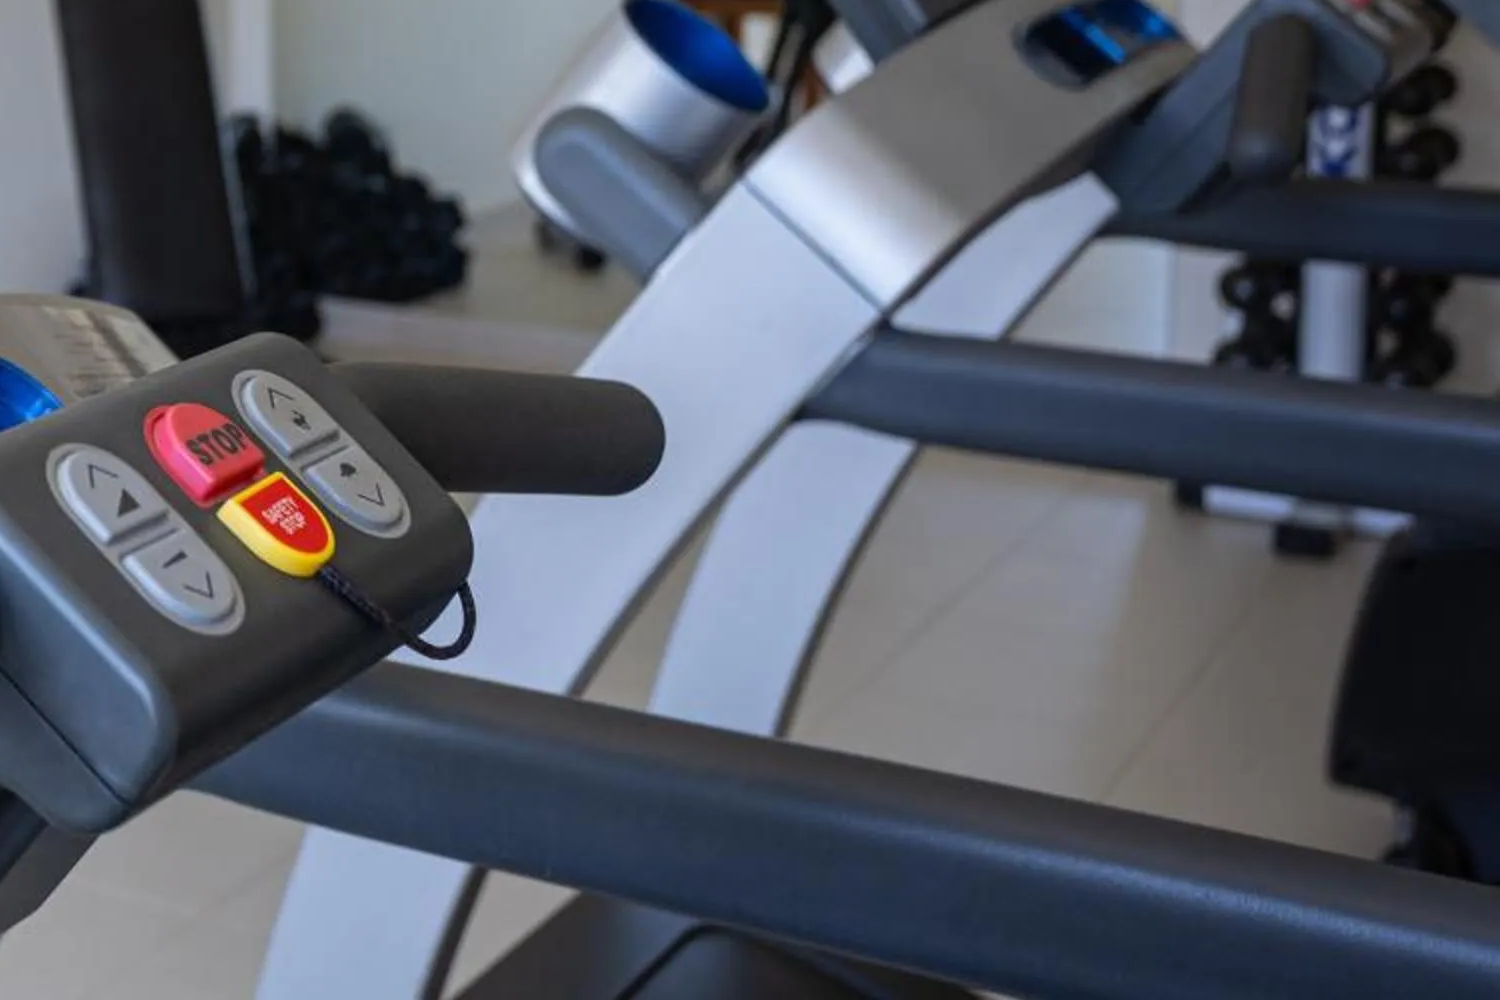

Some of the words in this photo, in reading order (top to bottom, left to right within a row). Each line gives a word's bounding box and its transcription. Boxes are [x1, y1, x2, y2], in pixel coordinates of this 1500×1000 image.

[186, 421, 247, 466] STOP
[260, 496, 299, 525] SAFETY
[279, 510, 307, 536] STOP
